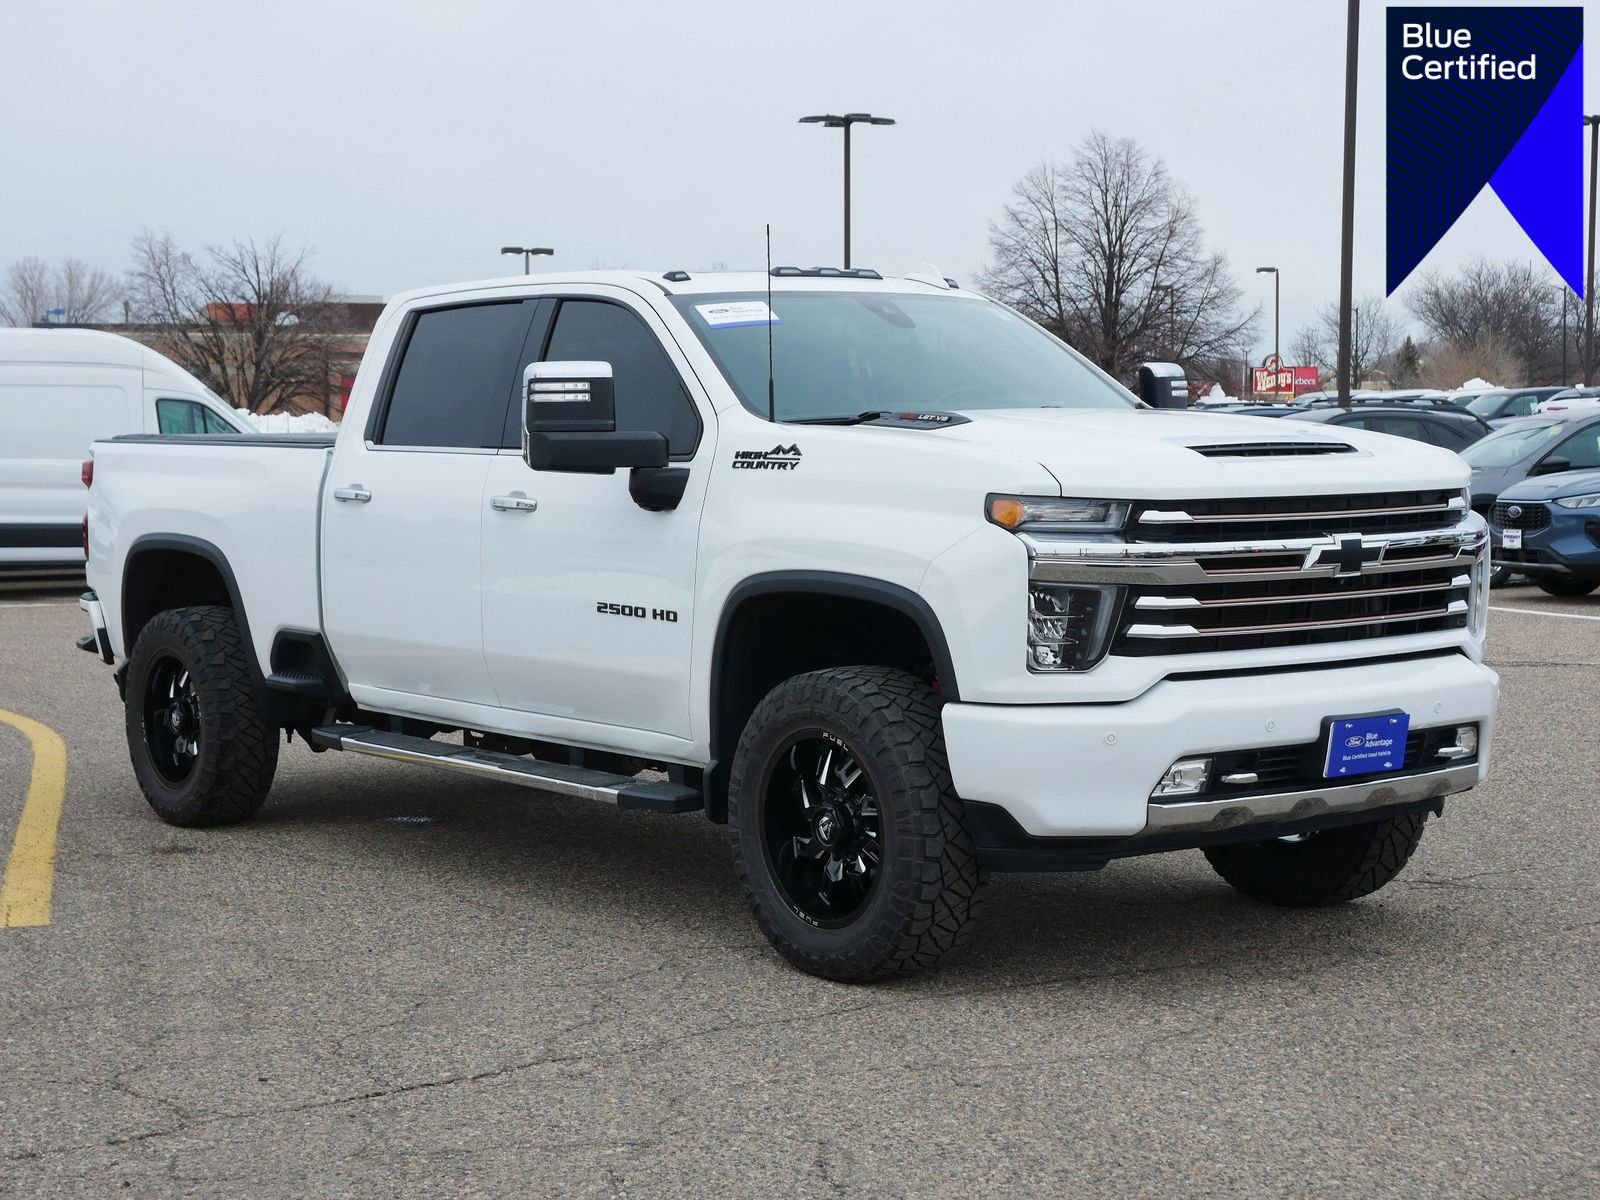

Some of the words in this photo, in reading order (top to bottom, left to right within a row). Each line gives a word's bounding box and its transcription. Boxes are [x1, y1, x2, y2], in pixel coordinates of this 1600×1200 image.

[734, 451, 768, 460] HIGH
[732, 460, 800, 471] COUNTRY
[597, 602, 646, 618] 2500
[652, 608, 678, 622] HD
[1347, 736, 1363, 747] Ford
[1366, 732, 1378, 740] Blue
[822, 732, 849, 752] FUEL
[1364, 738, 1393, 748] Advantage
